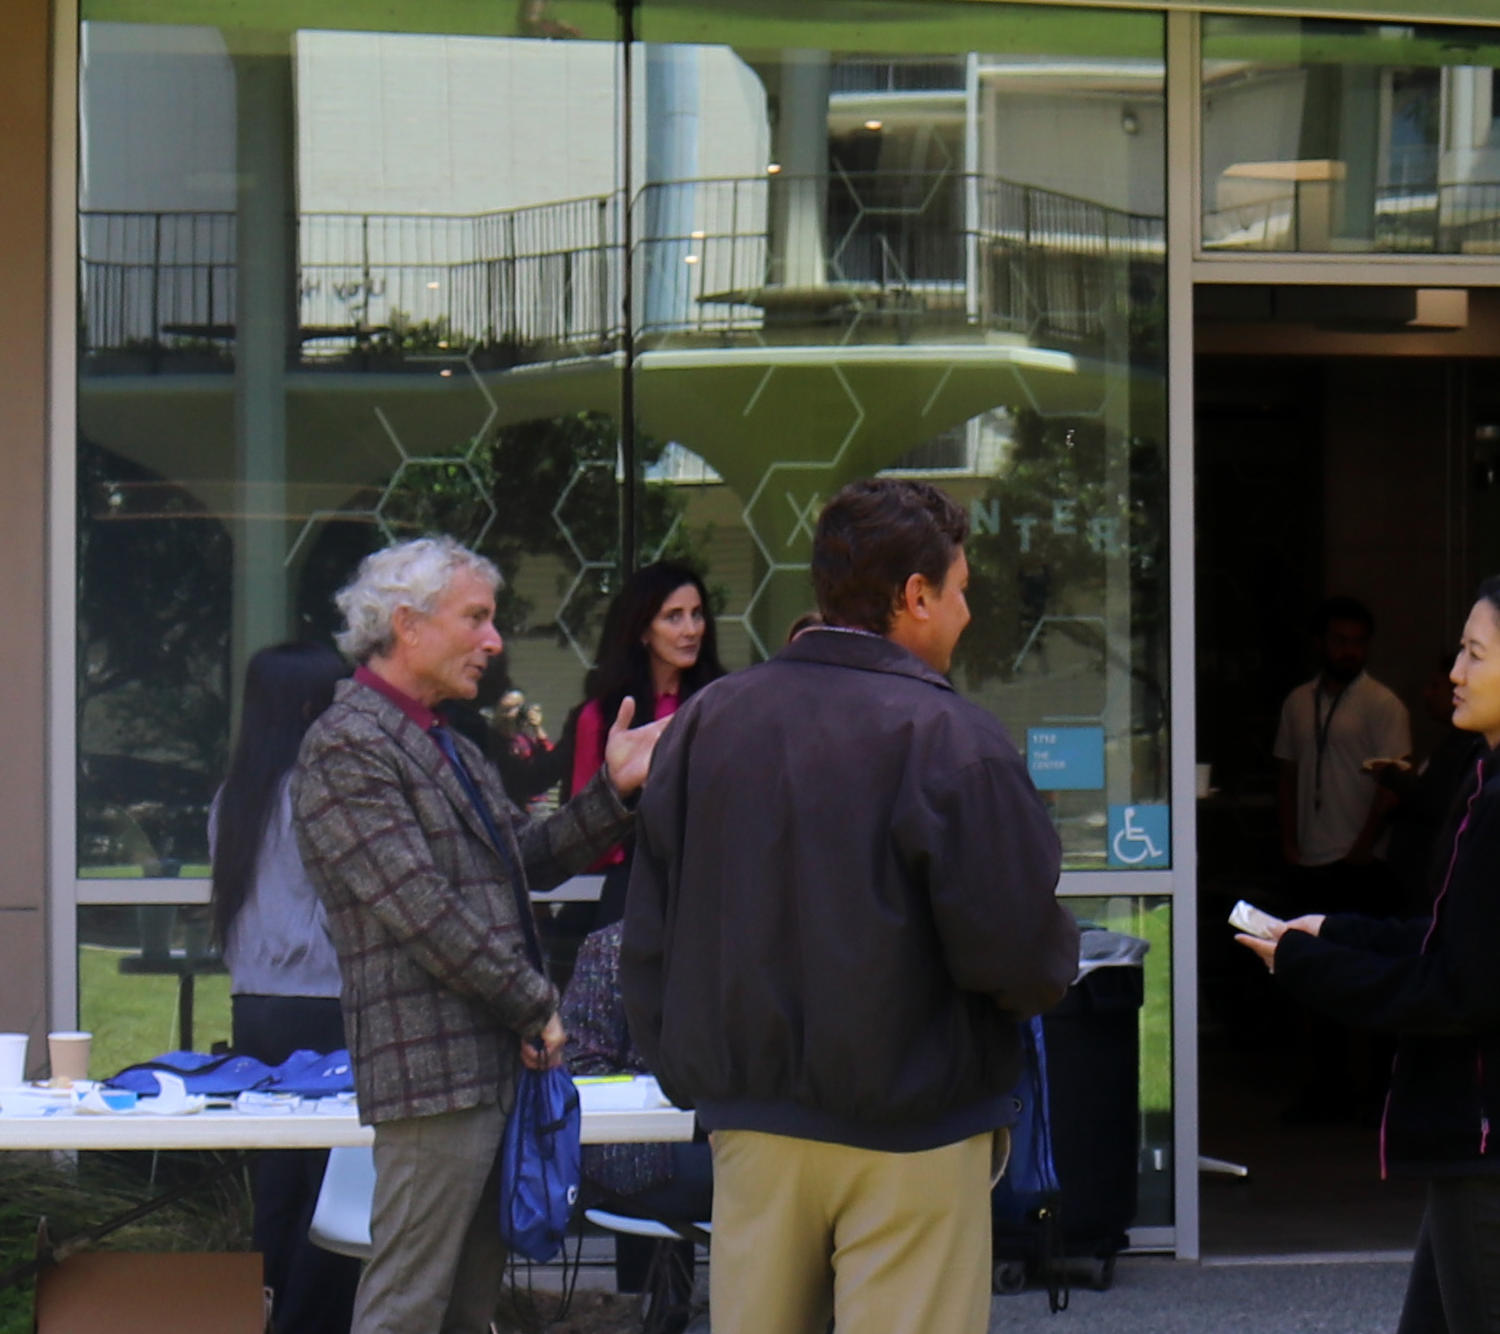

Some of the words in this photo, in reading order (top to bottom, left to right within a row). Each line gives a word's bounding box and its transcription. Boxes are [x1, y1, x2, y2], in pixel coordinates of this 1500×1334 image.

[970, 497, 1121, 554] NTER
[1032, 732, 1058, 745] 1712
[1032, 760, 1068, 771] CENTER
